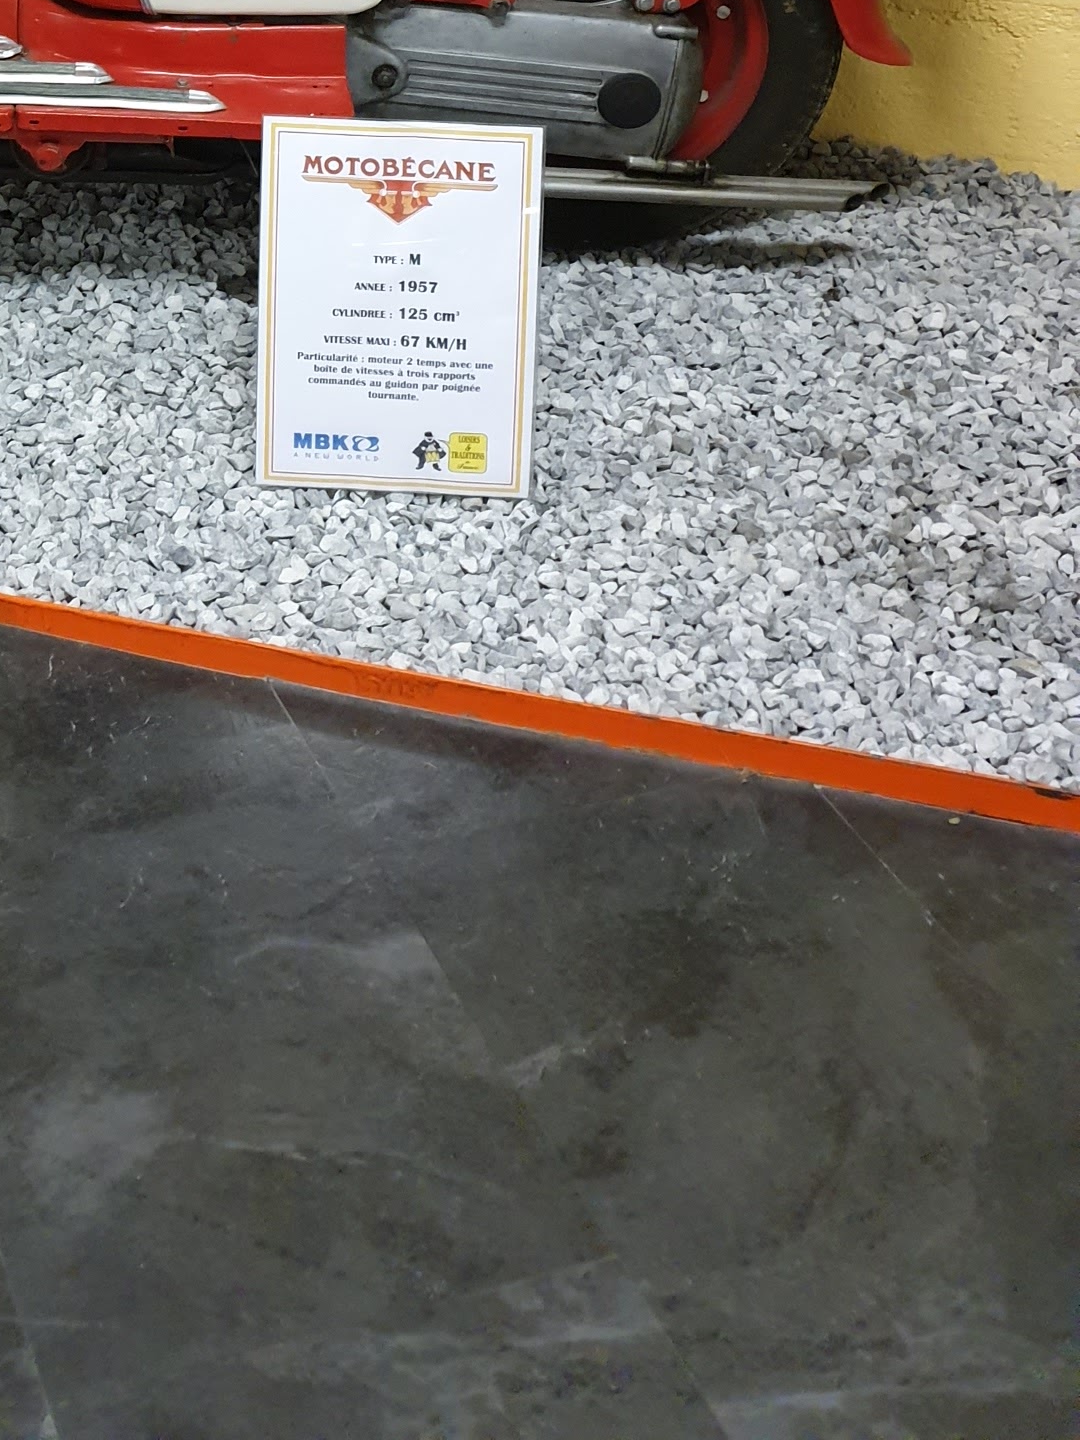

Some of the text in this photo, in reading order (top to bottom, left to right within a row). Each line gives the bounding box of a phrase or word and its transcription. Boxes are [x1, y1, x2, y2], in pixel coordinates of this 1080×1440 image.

[302, 155, 497, 181] MOTOBÉCANE
[373, 255, 398, 265] TYPE
[409, 253, 421, 266] M
[398, 280, 438, 294] 1957
[398, 307, 428, 321] 125
[323, 335, 363, 345] VITESSE
[366, 336, 391, 346] MAXI
[400, 334, 421, 348] 67
[425, 336, 467, 352] KM/H
[297, 351, 359, 363] Particularité
[367, 356, 404, 365] moteur
[406, 357, 414, 366] 2
[416, 358, 447, 369] temps
[449, 361, 472, 369] avec
[474, 362, 494, 370] une
[340, 365, 353, 374] de
[355, 366, 395, 377] vitesses
[406, 369, 430, 379] trois
[432, 372, 476, 381] rapports
[369, 380, 382, 388] au
[384, 380, 419, 390] guidon
[421, 383, 440, 392] par
[441, 383, 481, 394] poignée
[367, 390, 419, 402] tournante.
[293, 432, 350, 452] MBK
[304, 452, 330, 460] NEW
[336, 453, 380, 462] WORLD
